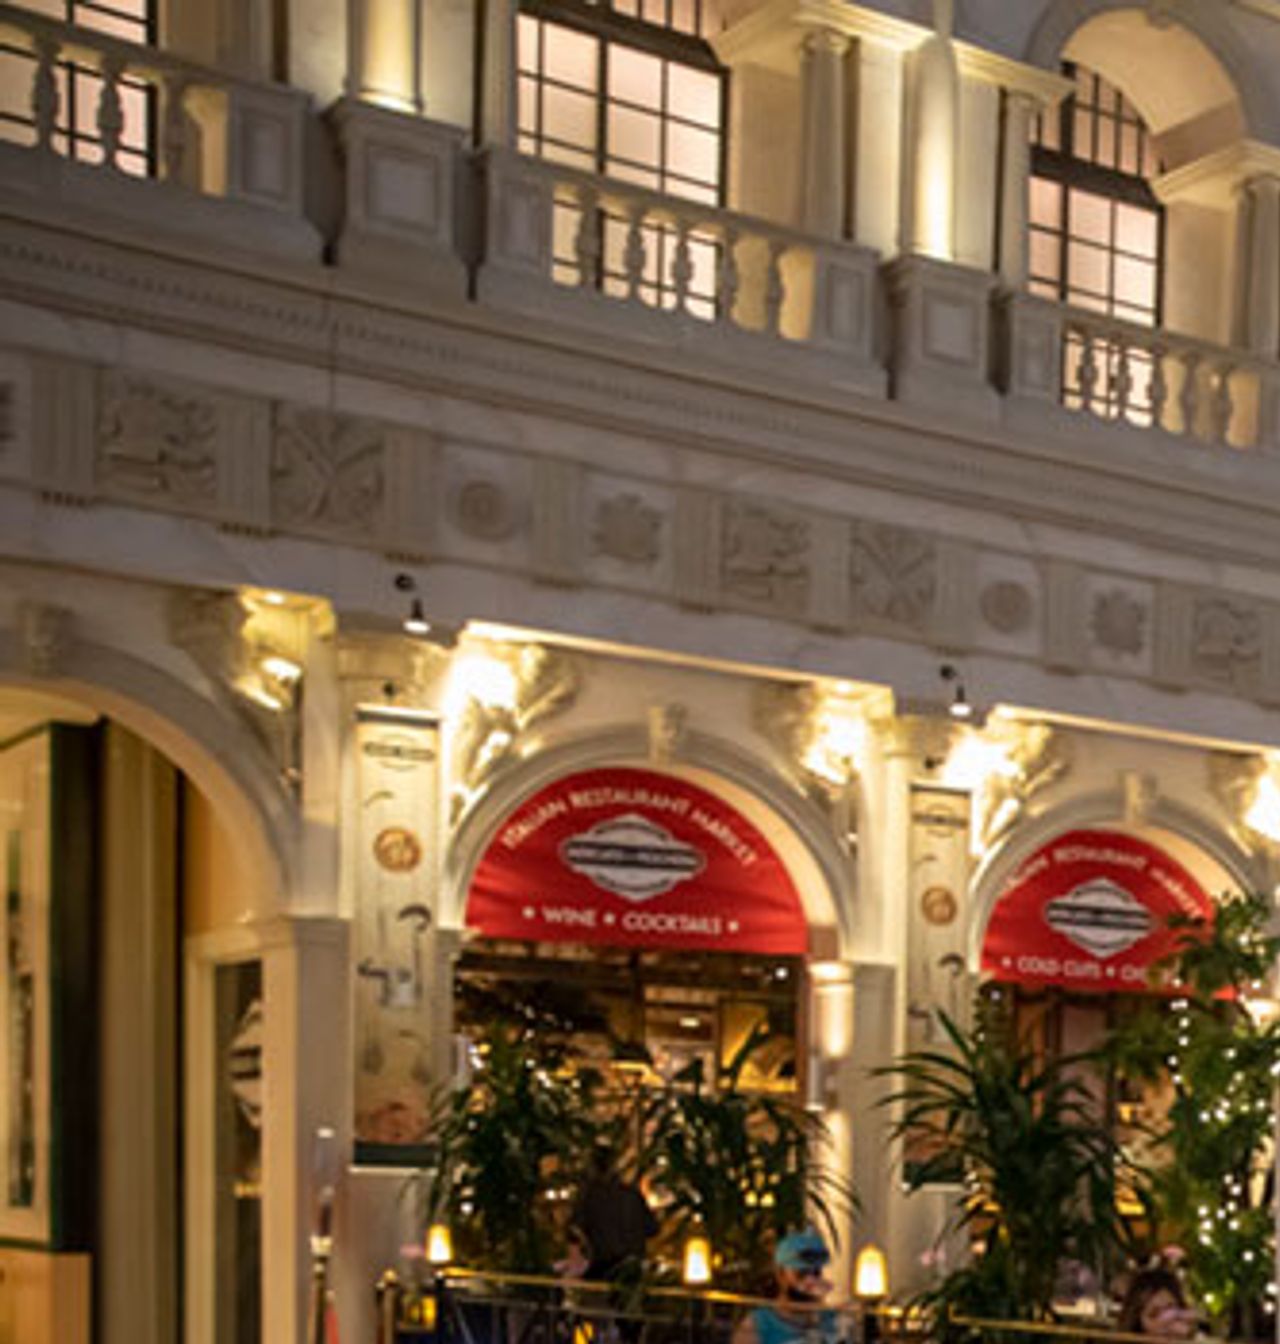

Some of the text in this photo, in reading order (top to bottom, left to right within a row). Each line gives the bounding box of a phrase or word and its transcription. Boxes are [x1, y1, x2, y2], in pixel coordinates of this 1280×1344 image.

[502, 798, 567, 849] ITALIAN
[569, 786, 691, 816] RESTAURANT
[691, 809, 758, 866] MARKET
[542, 907, 722, 934] WINE COCKTAILS
